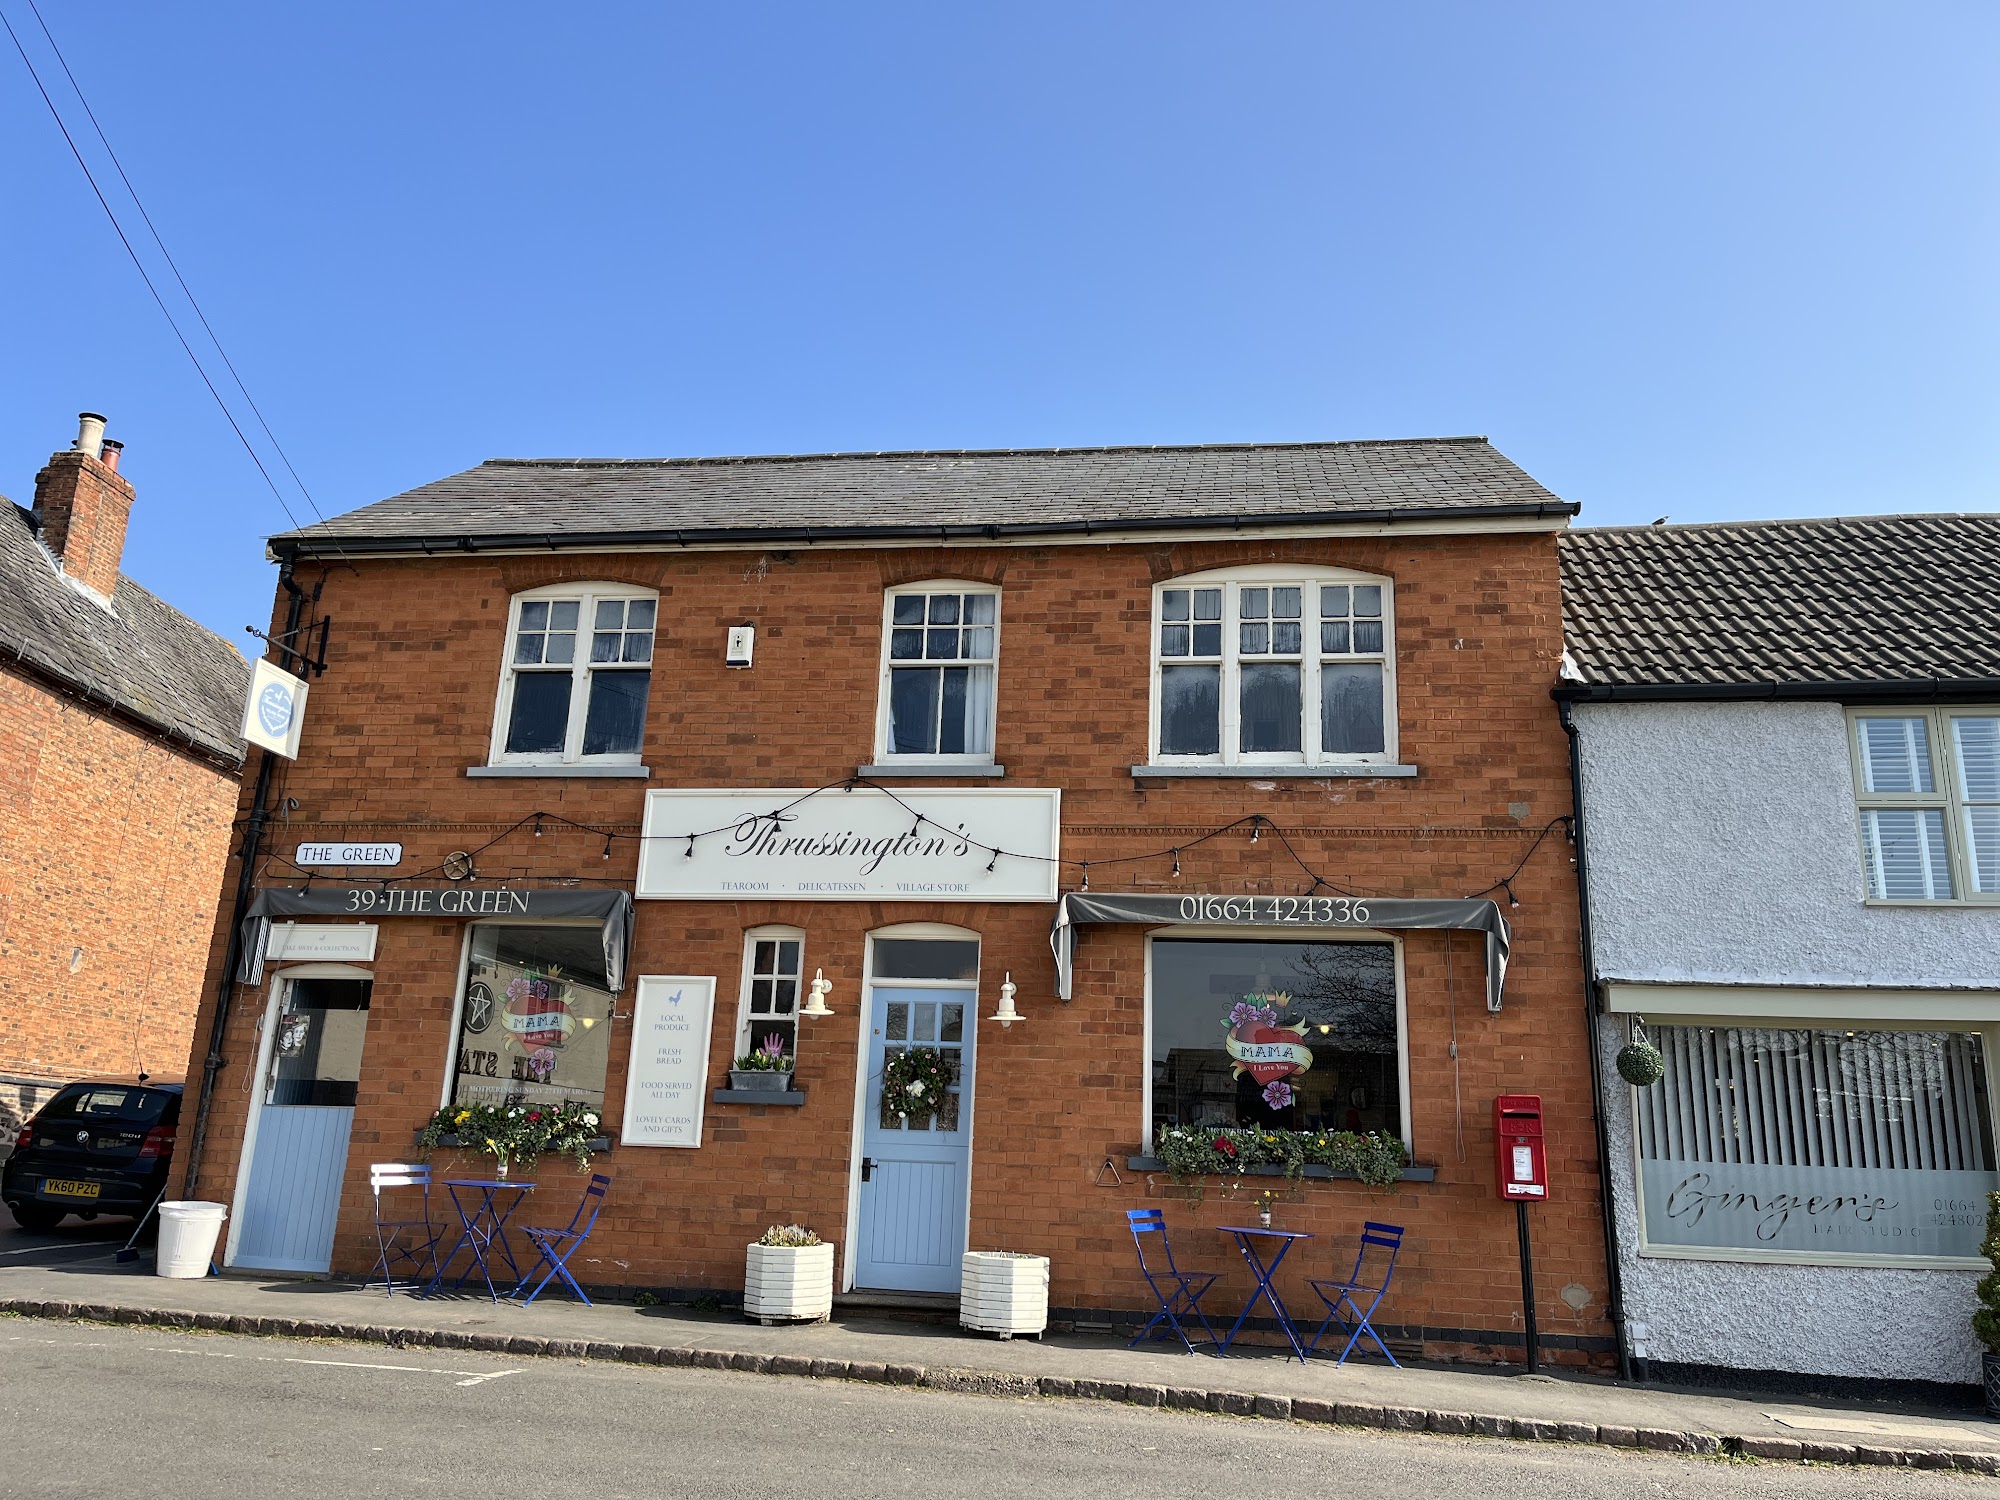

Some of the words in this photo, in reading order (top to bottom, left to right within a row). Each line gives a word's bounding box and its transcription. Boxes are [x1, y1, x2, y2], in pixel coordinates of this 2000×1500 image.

[725, 812, 971, 876] Thrussington's
[303, 847, 332, 861] THE
[342, 847, 395, 861] GREEN
[721, 882, 769, 891] TEAROOM
[798, 882, 866, 891] DELICATESSEN
[896, 883, 936, 892] VILLAGE
[937, 883, 970, 892] STORE
[345, 889, 376, 912] 39
[385, 890, 433, 912] THE
[439, 890, 530, 913] GREEN
[1180, 896, 1258, 921] 01664
[1266, 897, 1370, 922] 424336
[513, 1016, 560, 1028] MAMA
[660, 1014, 686, 1022] LOCAL
[528, 1033, 542, 1041] Love
[658, 1048, 682, 1056] FRESH
[1240, 1046, 1294, 1059] MAMA
[656, 1057, 682, 1065] BREAD
[1258, 1064, 1275, 1072] Love
[1275, 1063, 1289, 1071] You
[469, 1085, 514, 1094] MOTHERING
[514, 1087, 544, 1095] SUNDAY
[563, 1088, 592, 1096] MARCH
[641, 1081, 664, 1089] FOOD
[665, 1082, 692, 1090] SERVED
[650, 1091, 664, 1099] ALL
[665, 1091, 681, 1099] DAY
[636, 1116, 663, 1124] LOVELY
[665, 1116, 691, 1124] CARDS
[661, 1126, 683, 1134] GIFTS
[48, 1180, 75, 1192] YK60
[77, 1183, 99, 1195] PZC
[1666, 1172, 1899, 1241] Ginger's
[1934, 1198, 1976, 1212] 01664
[1930, 1214, 1984, 1227] 424802
[1814, 1223, 1852, 1234] HAIR
[1862, 1226, 1921, 1237] STUDIO
